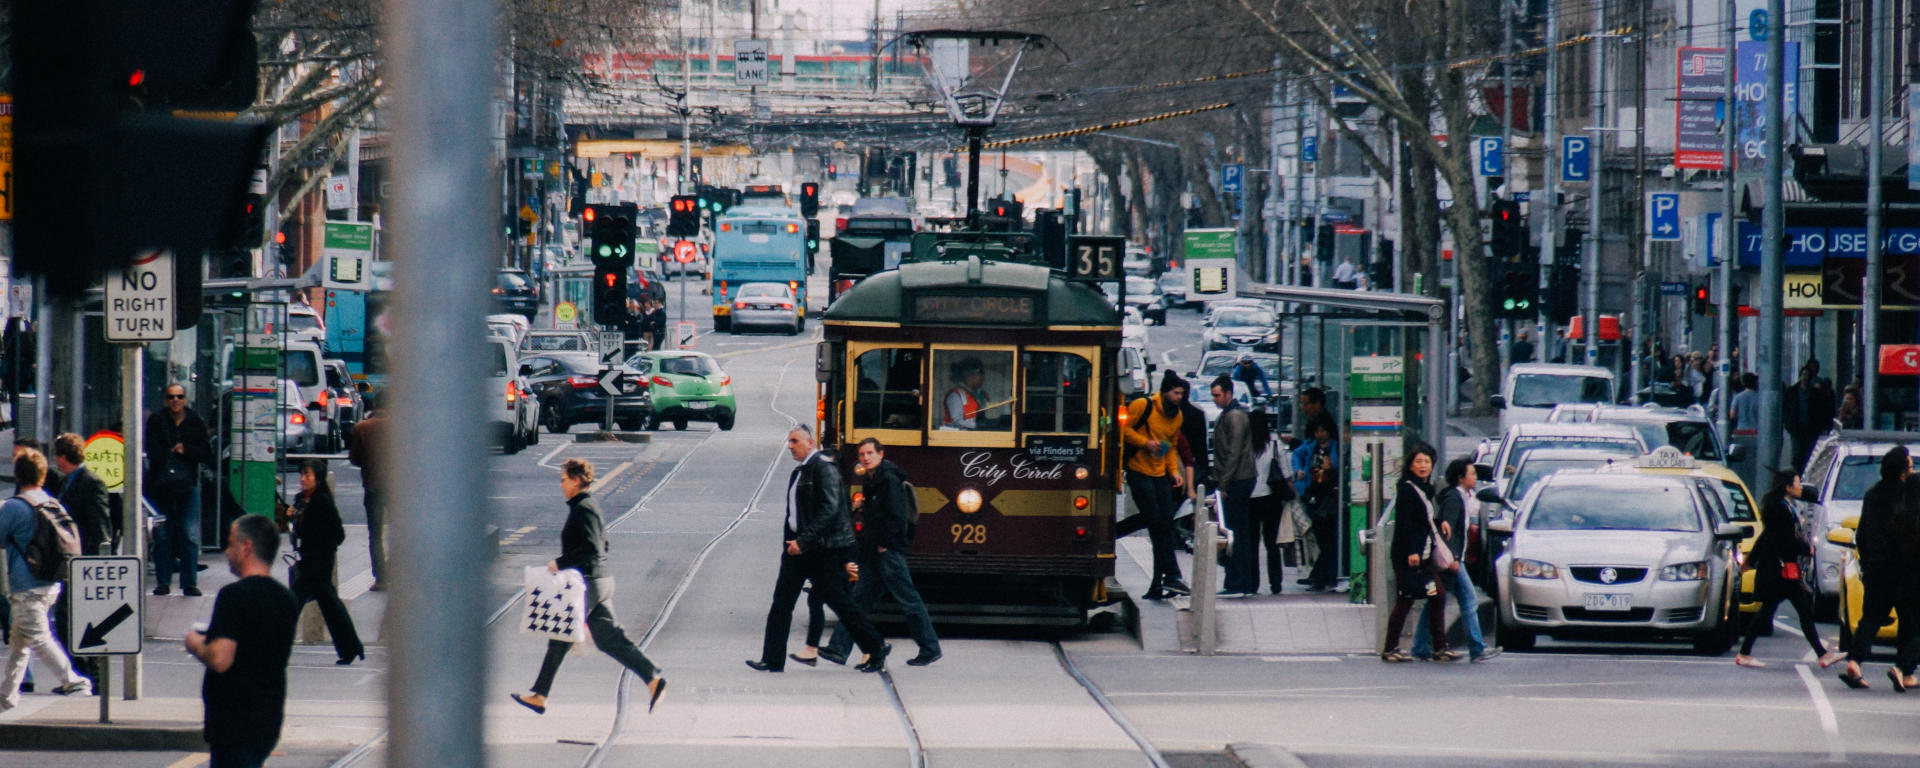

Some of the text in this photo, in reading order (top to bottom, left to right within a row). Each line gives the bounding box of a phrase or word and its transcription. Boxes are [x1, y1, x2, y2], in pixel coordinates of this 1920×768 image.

[738, 69, 764, 80] LANE
[1739, 82, 1795, 102] HOE
[1484, 140, 1498, 157] P
[1568, 140, 1584, 159] P
[1226, 167, 1238, 182] P
[1657, 197, 1674, 218] P
[1076, 245, 1113, 276] 35
[122, 271, 157, 291] NO
[113, 298, 167, 312] RIGHT
[969, 296, 1030, 313] CIRCLE
[115, 318, 164, 332] TURN
[1029, 446, 1084, 456] via Flinders St
[1660, 450, 1679, 459] TAXI
[960, 451, 1065, 486] City Circle
[950, 523, 987, 544] 928
[83, 566, 129, 581] KEEP
[84, 586, 127, 601] LEFT
